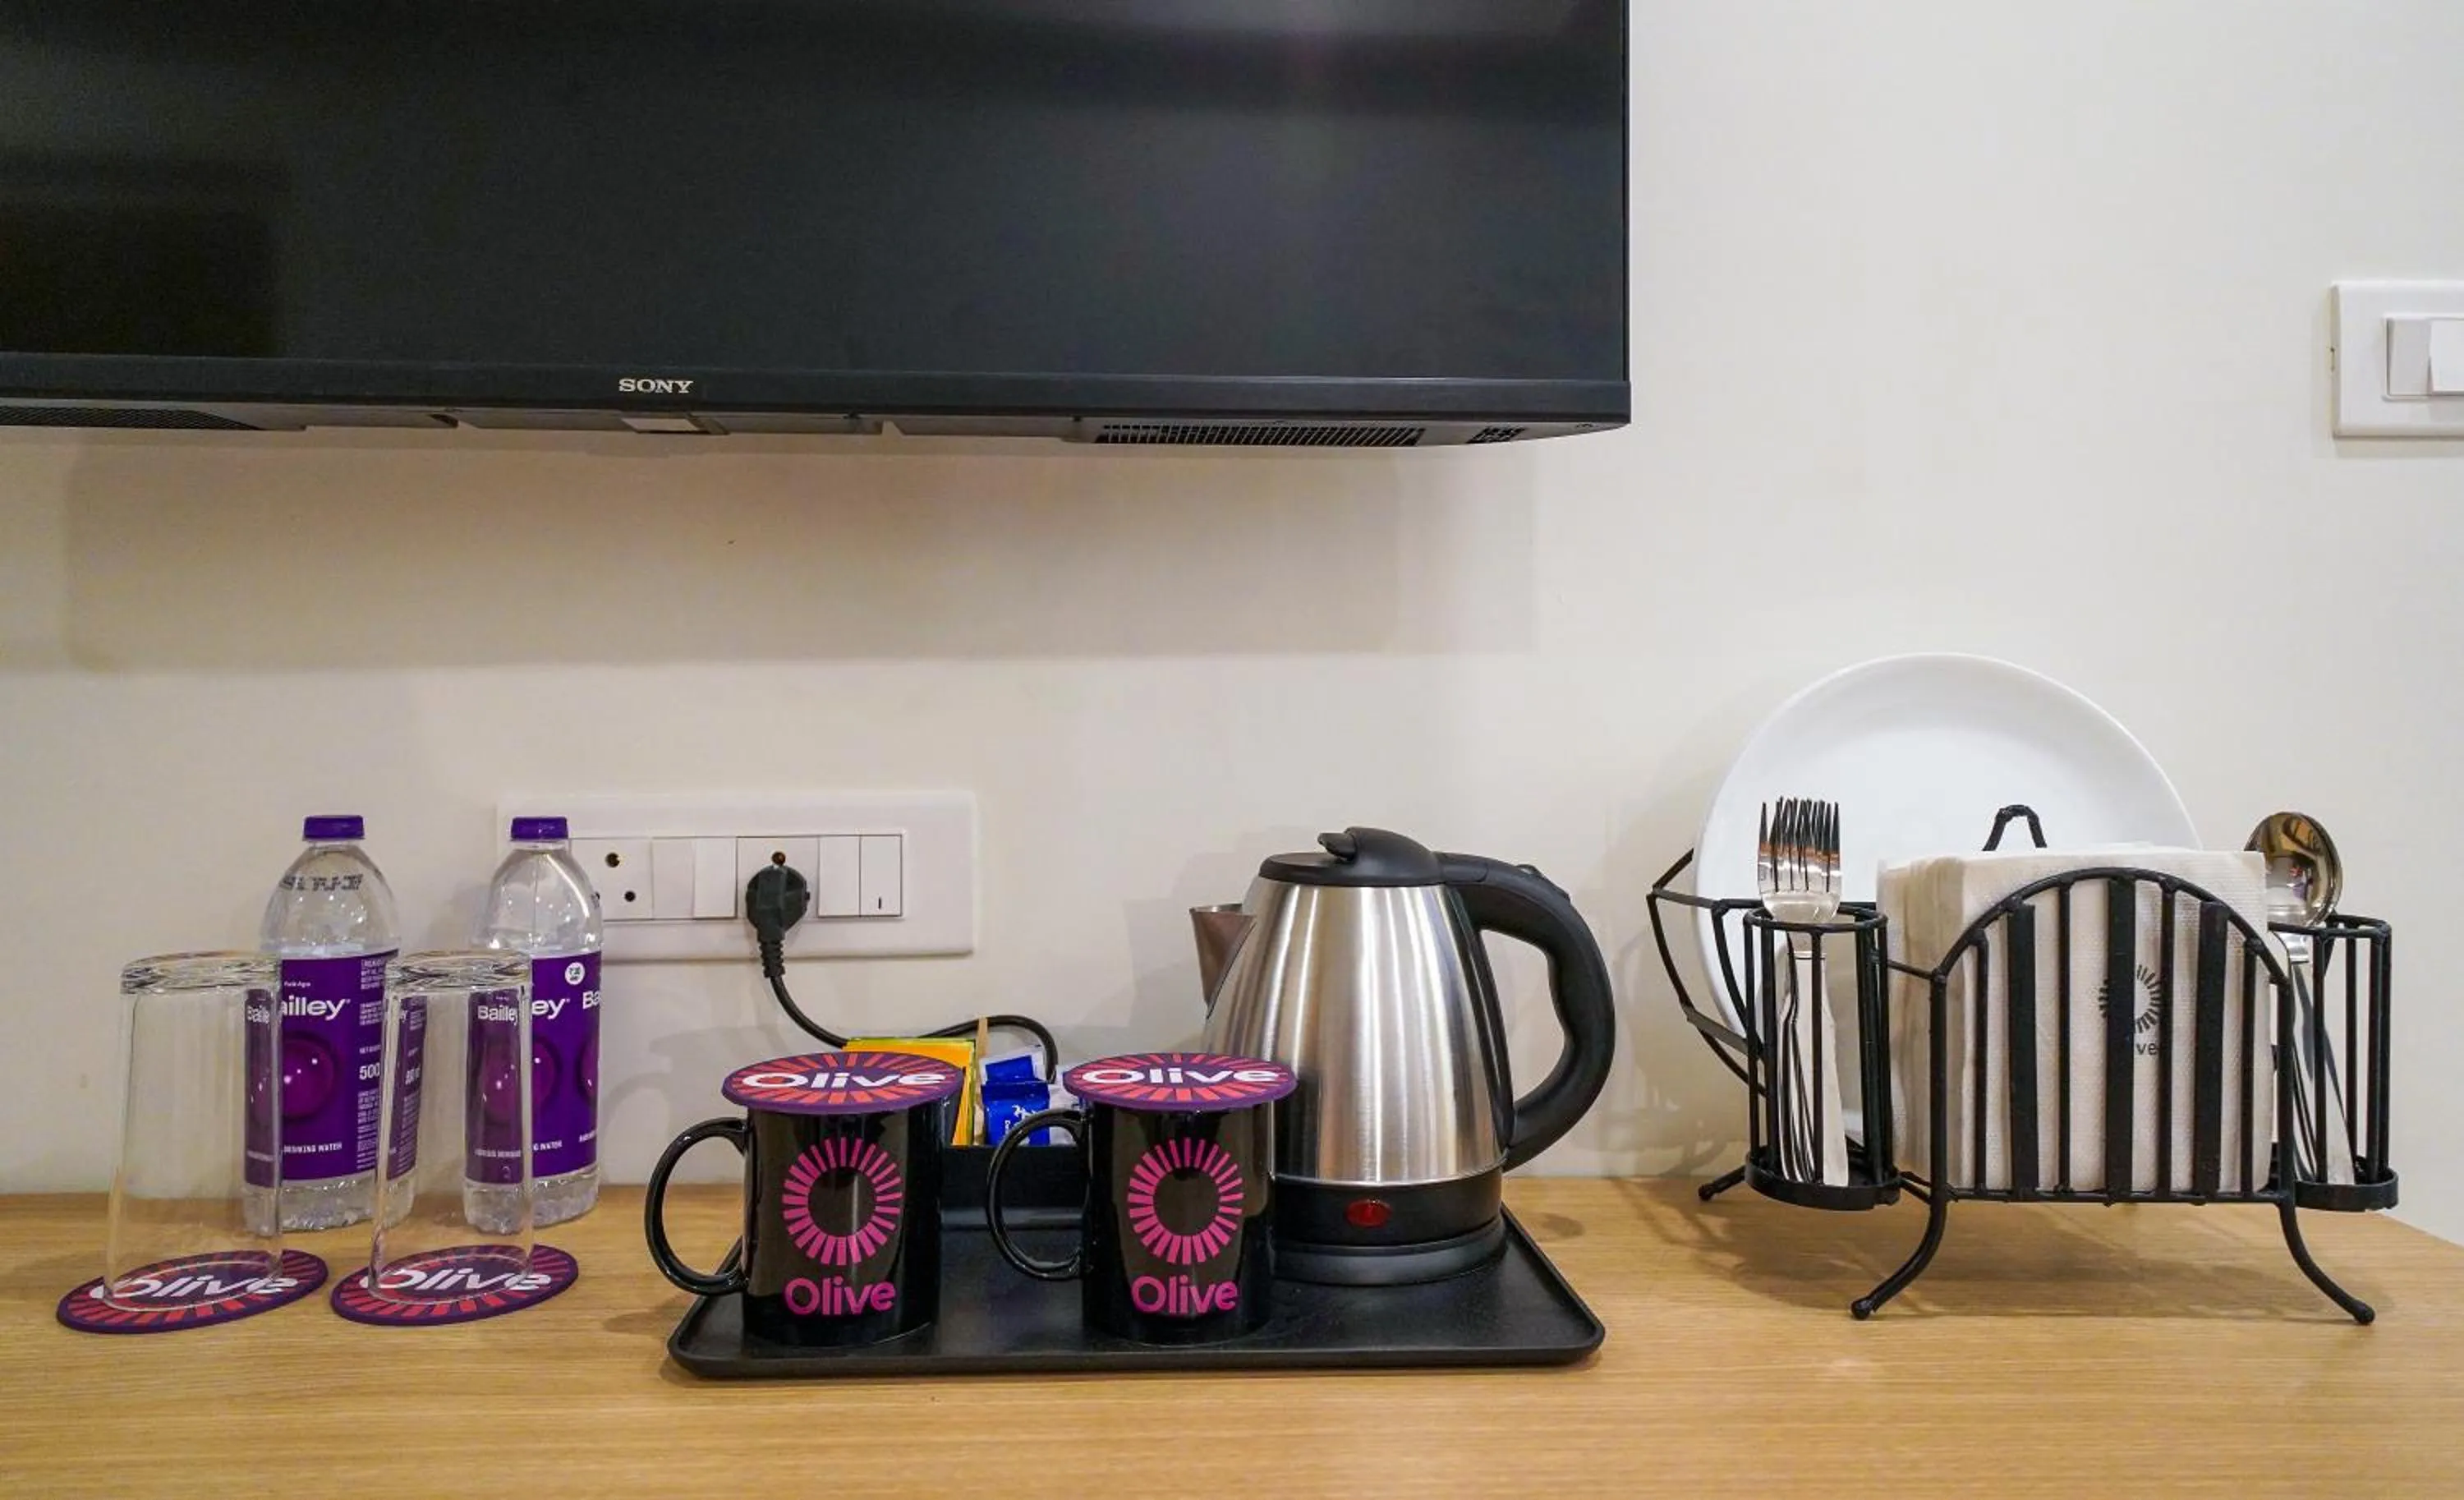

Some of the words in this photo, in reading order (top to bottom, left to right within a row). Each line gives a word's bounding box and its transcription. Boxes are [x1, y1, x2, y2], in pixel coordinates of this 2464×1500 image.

[618, 378, 694, 393] SONY
[280, 994, 347, 1022] ailley
[742, 1071, 947, 1088] Olive
[1081, 1067, 1281, 1084] Olive
[318, 1142, 342, 1153] WATER
[89, 1275, 298, 1299] Olive
[358, 1268, 552, 1291] Olive
[784, 1275, 896, 1315] Olive
[1131, 1274, 1239, 1314] Olive
